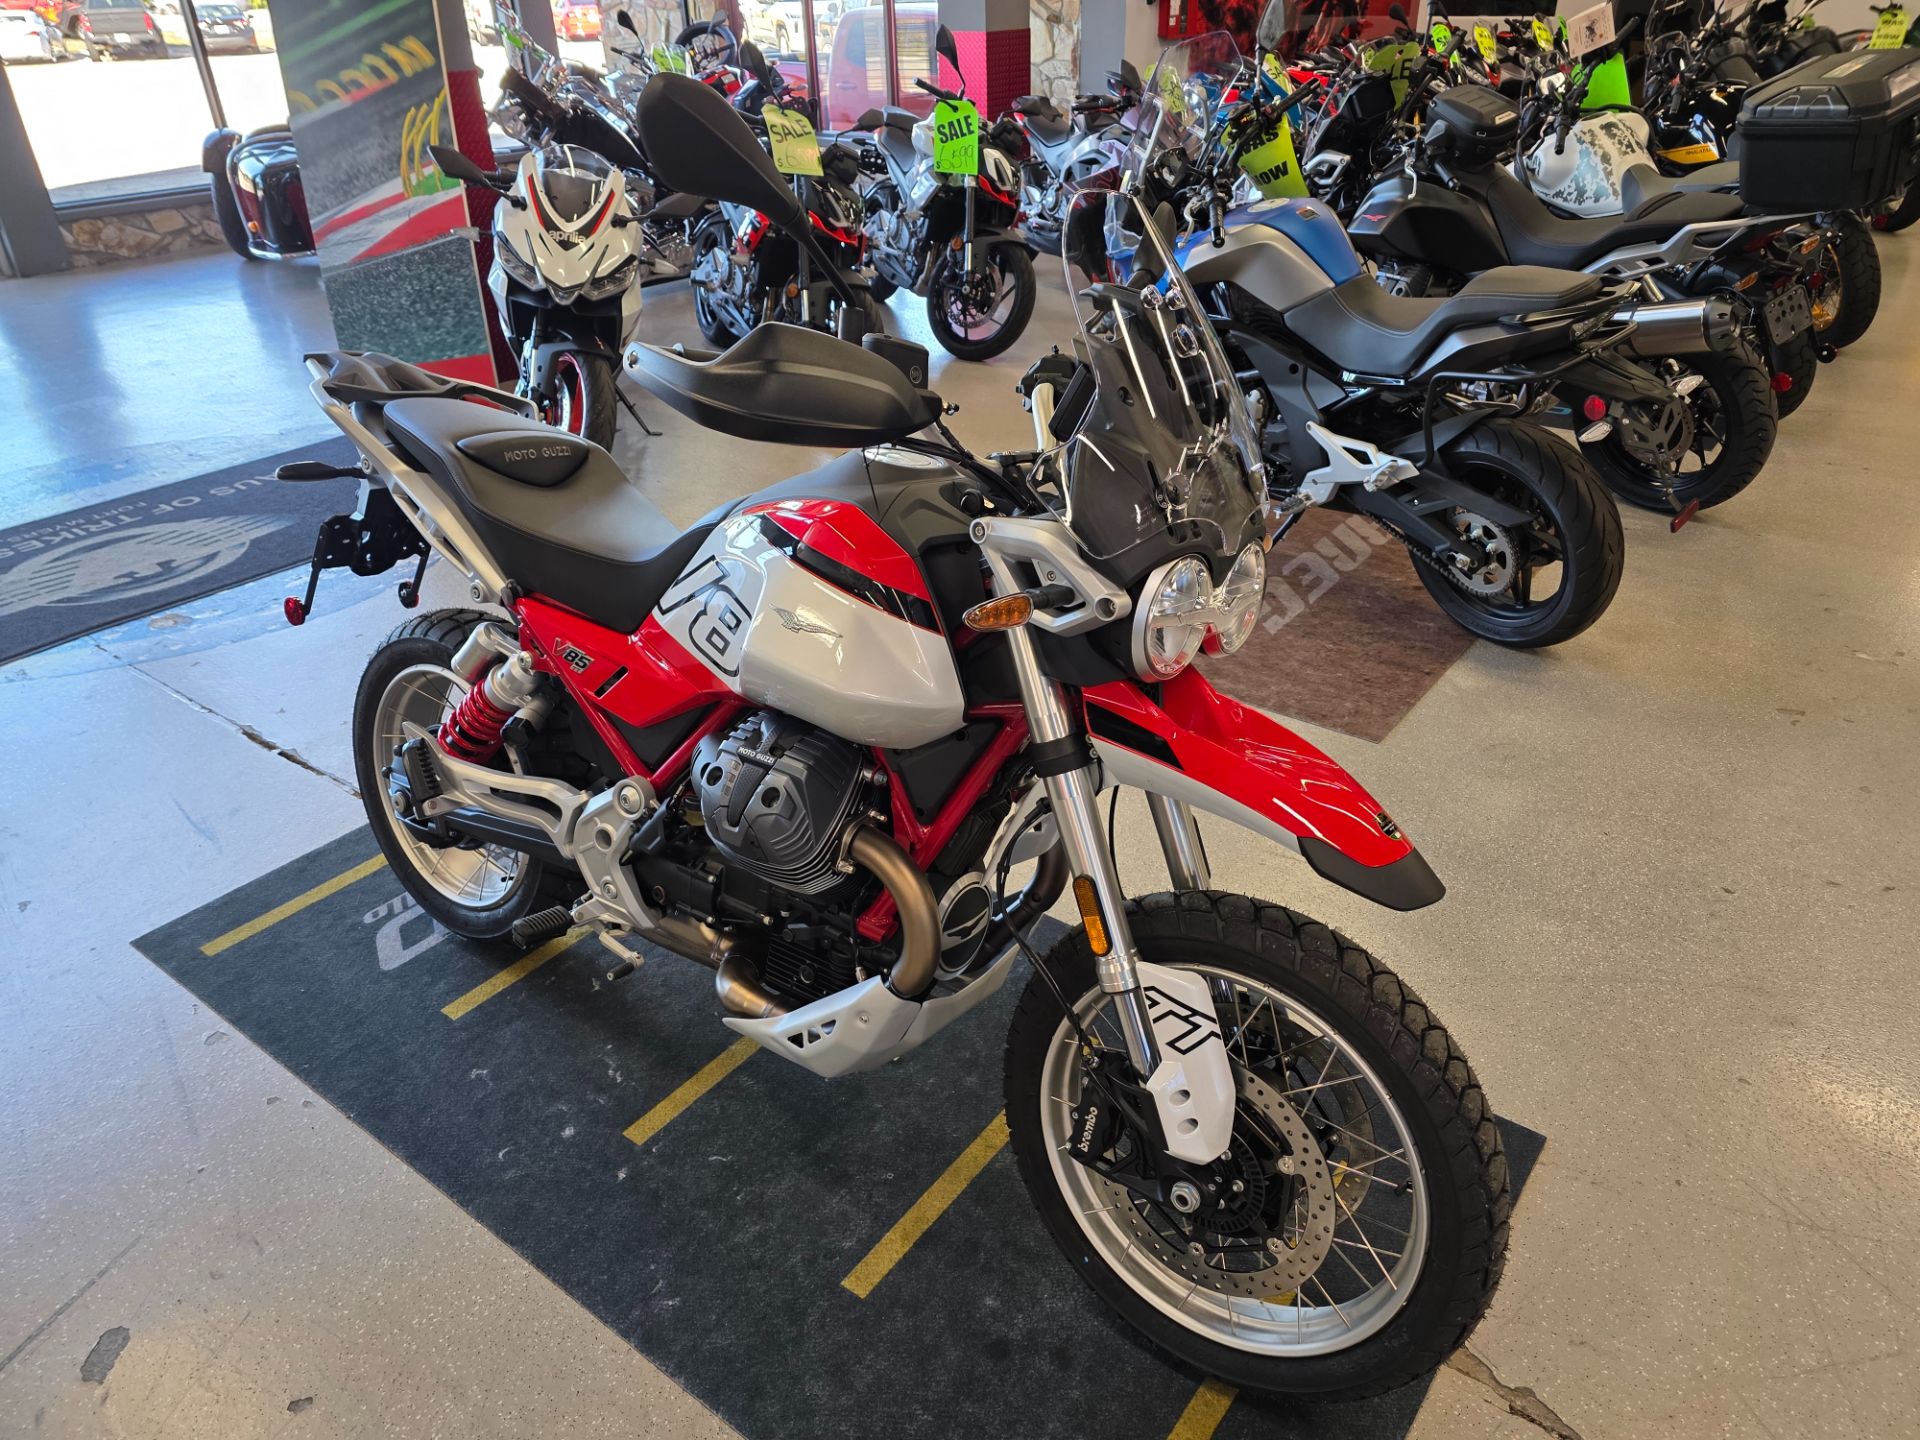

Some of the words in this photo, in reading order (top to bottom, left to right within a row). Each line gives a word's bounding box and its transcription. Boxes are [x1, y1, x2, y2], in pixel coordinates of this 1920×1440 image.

[769, 119, 812, 144] SALE
[937, 114, 975, 144] SALE
[549, 230, 587, 244] aprilia
[503, 448, 537, 462] MOTO
[541, 445, 571, 458] GUZZI
[151, 495, 202, 515] OF
[0, 514, 143, 560] TRIKES
[551, 636, 594, 670] V85
[738, 746, 756, 757] MOTO
[756, 753, 776, 764] GUZZI
[1077, 1106, 1098, 1153] brembo
